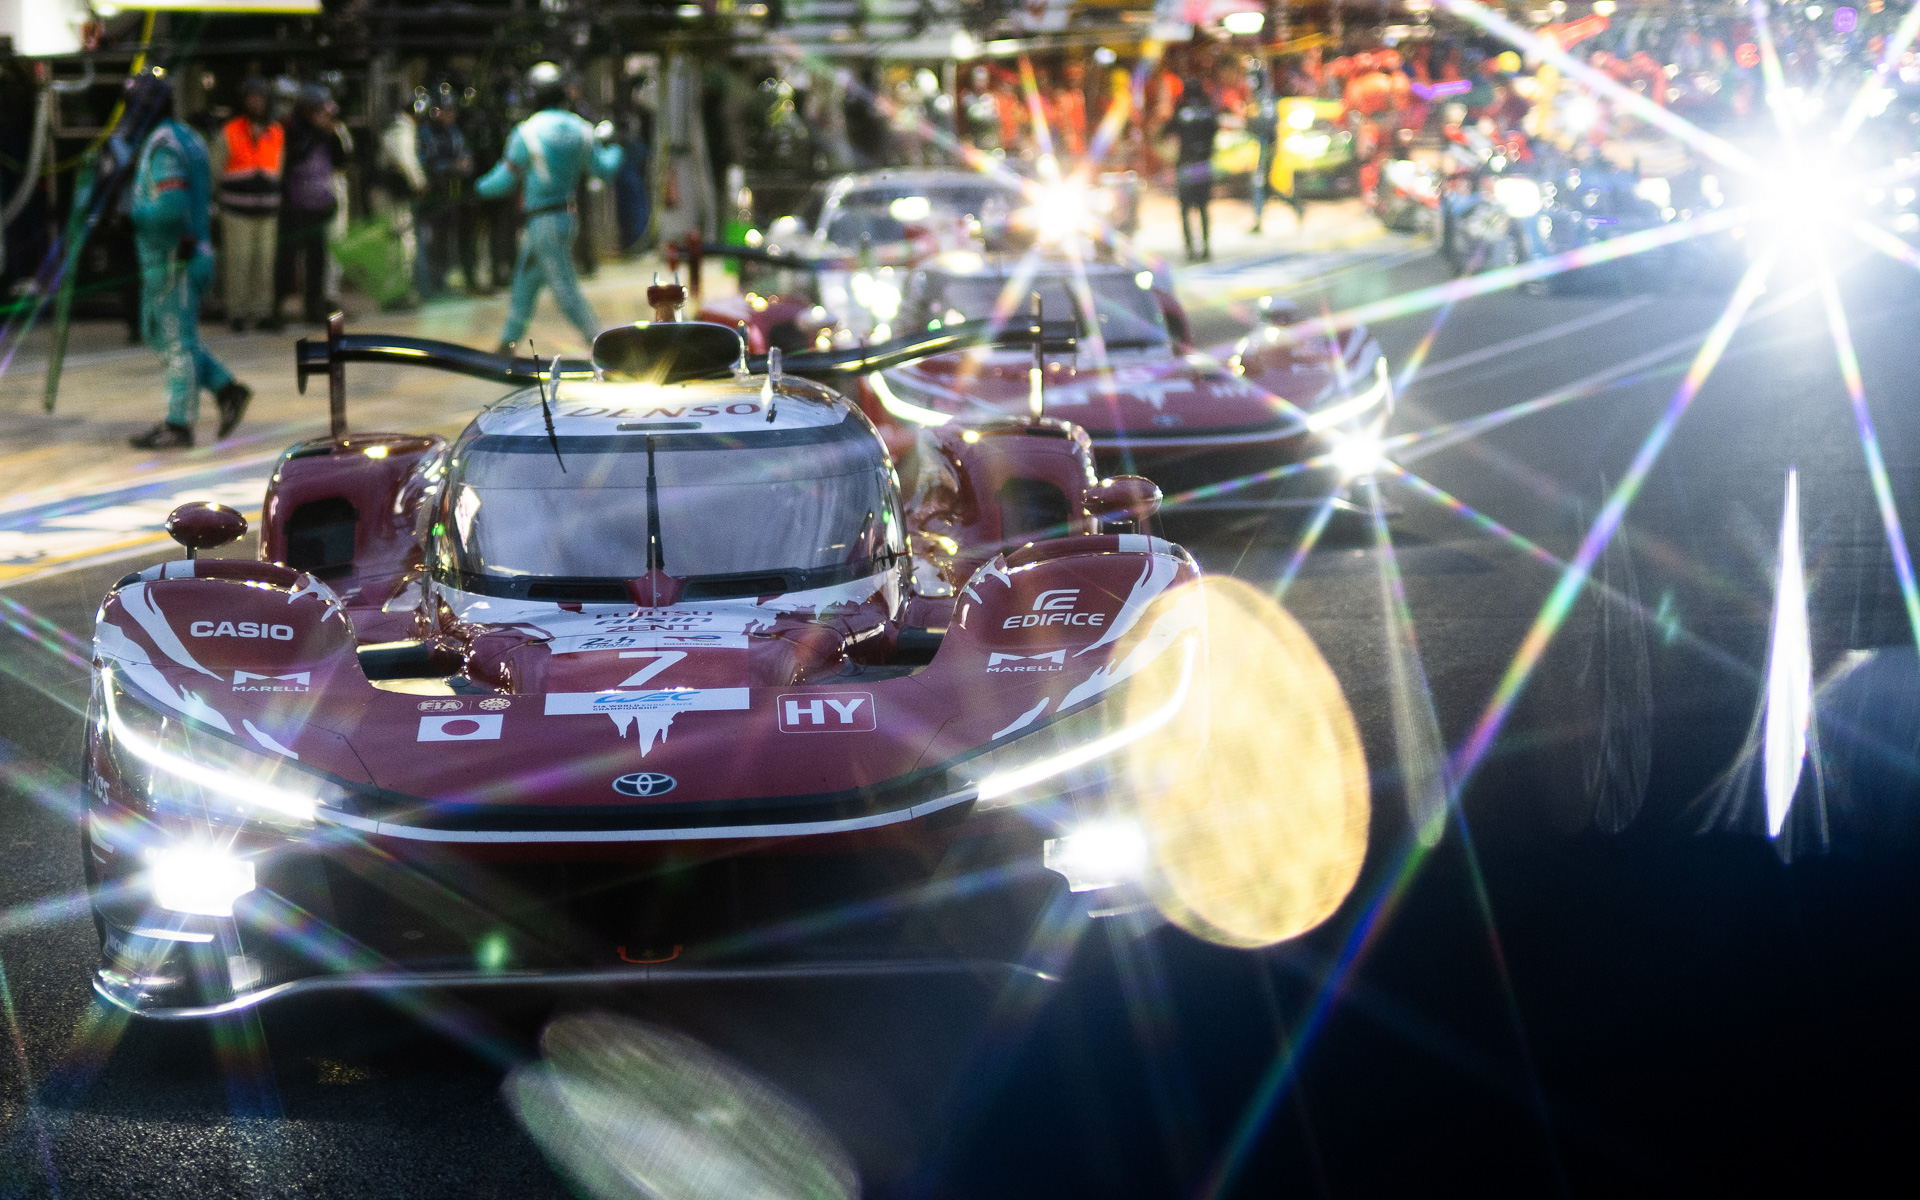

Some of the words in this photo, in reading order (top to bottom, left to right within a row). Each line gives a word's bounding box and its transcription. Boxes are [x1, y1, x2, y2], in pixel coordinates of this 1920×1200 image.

[563, 403, 760, 418] DENSO
[1002, 612, 1106, 629] EDIFICE
[190, 620, 294, 640] CASIO
[605, 624, 699, 633] ZENT
[617, 650, 688, 687] 7
[986, 665, 1064, 673] MARELLI
[593, 691, 701, 704] WEC
[419, 699, 460, 712] FIA
[785, 698, 866, 725] HY
